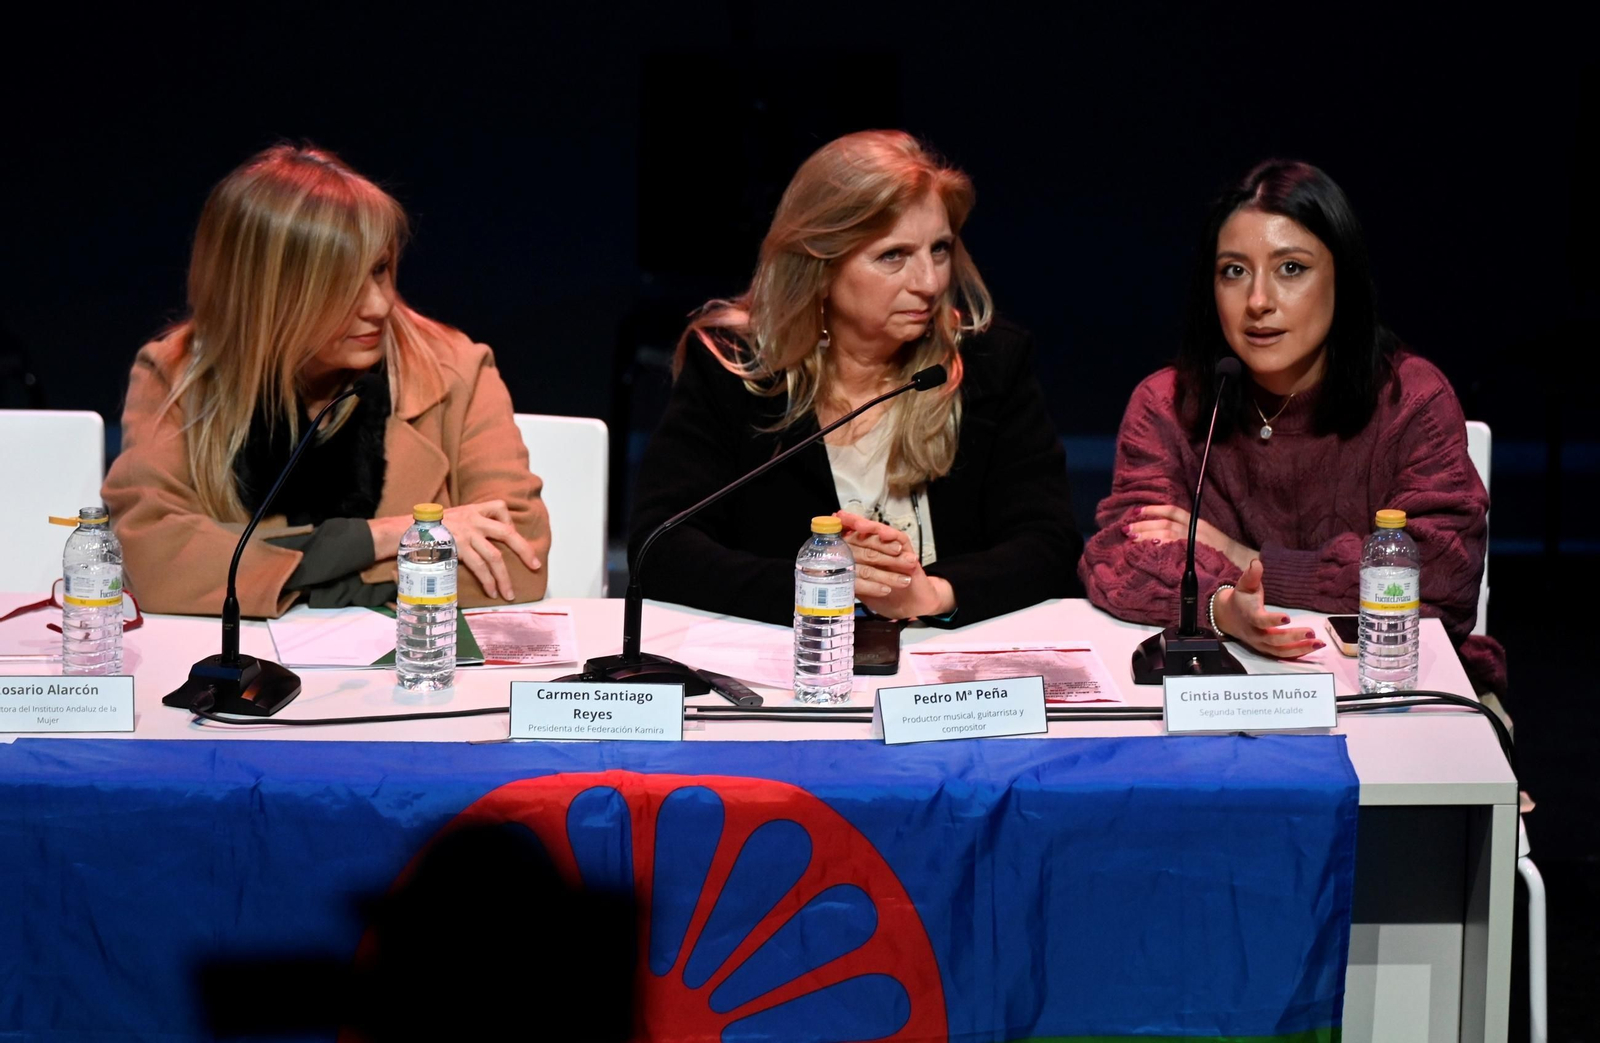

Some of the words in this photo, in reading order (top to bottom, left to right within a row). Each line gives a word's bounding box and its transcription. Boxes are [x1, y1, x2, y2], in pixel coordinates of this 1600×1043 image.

[0, 684, 43, 695] osario
[47, 684, 98, 695] Alarcón
[1180, 690, 1220, 702] Cintia
[1224, 690, 1269, 701] Bustos
[1272, 688, 1317, 700] Muñoz
[537, 689, 590, 700] Carmen
[594, 690, 653, 704] Santiago
[914, 692, 952, 705] Pedro
[976, 687, 1008, 700] Peña
[18, 705, 30, 713] del
[32, 705, 64, 713] Instituto
[66, 705, 97, 713] Andaluz
[98, 705, 108, 713] de
[110, 705, 117, 713] la
[1199, 708, 1235, 717] Segunda
[1237, 707, 1272, 716] Teniente
[1274, 706, 1304, 715] Alcalde
[37, 717, 60, 725] Mujer
[573, 709, 612, 723] Reyes
[902, 714, 942, 724] Productor
[943, 711, 976, 720] musical,
[977, 708, 1018, 720] guitarrista
[1019, 709, 1024, 717] y
[528, 724, 572, 733] Presidenta
[574, 724, 585, 733] de
[587, 724, 633, 733] Federación
[634, 726, 664, 734] Kamira
[942, 723, 987, 734] compositor
